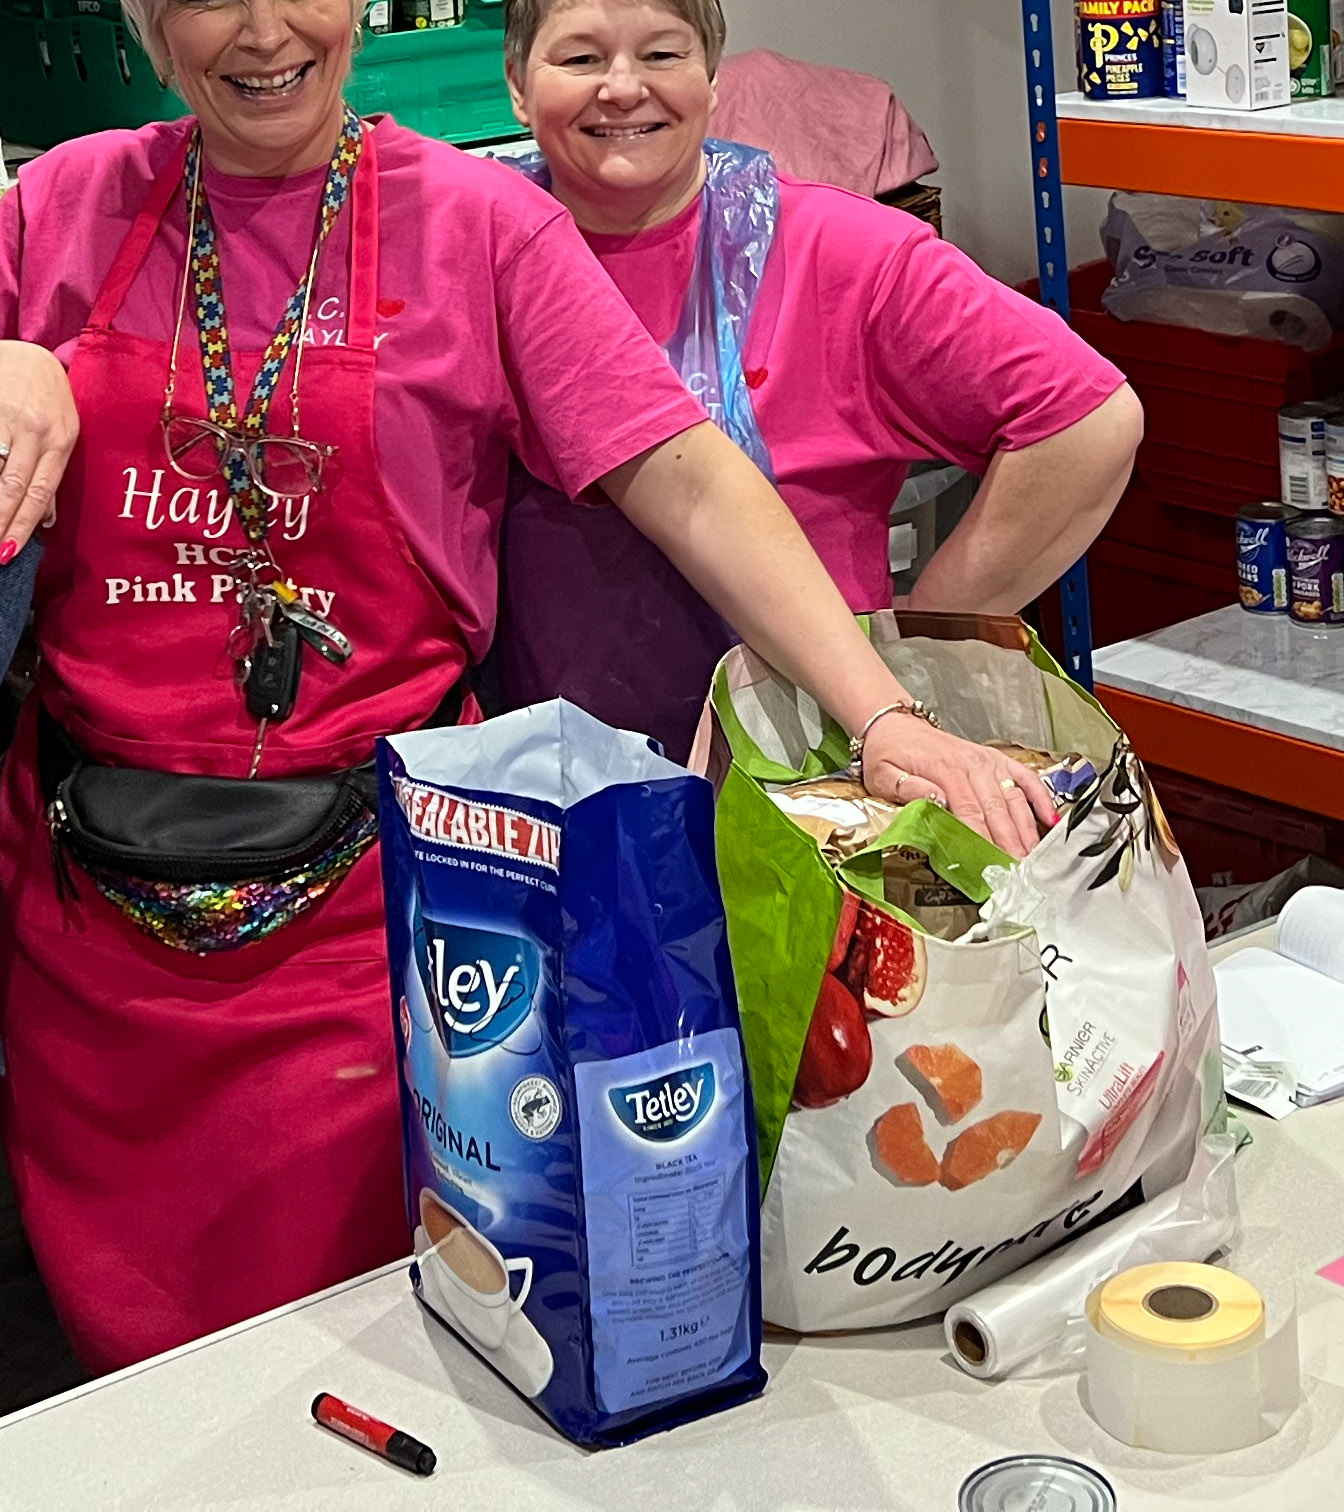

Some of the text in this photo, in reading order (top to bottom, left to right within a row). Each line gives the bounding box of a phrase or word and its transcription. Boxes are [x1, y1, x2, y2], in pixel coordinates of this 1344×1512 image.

[1122, 0, 1156, 15] PACK
[1104, 53, 1137, 63] PRINCES
[1105, 63, 1143, 75] PINEAPPLE
[1105, 73, 1131, 82] PIECES
[1189, 245, 1255, 267] soft
[117, 467, 311, 542] Hayey
[105, 574, 198, 605] Pink
[1297, 582, 1320, 592] PORK
[426, 853, 459, 868] LOCKED
[460, 860, 470, 870] IN
[471, 861, 488, 873] FOR
[489, 865, 505, 878] THE
[506, 868, 540, 888] PERFECT
[426, 938, 520, 1034] ley
[1098, 1061, 1135, 1111] UltraLift
[625, 1078, 705, 1124] Tetley
[656, 1153, 698, 1170] BLACK TEA
[660, 1321, 699, 1342] 1.31kg
